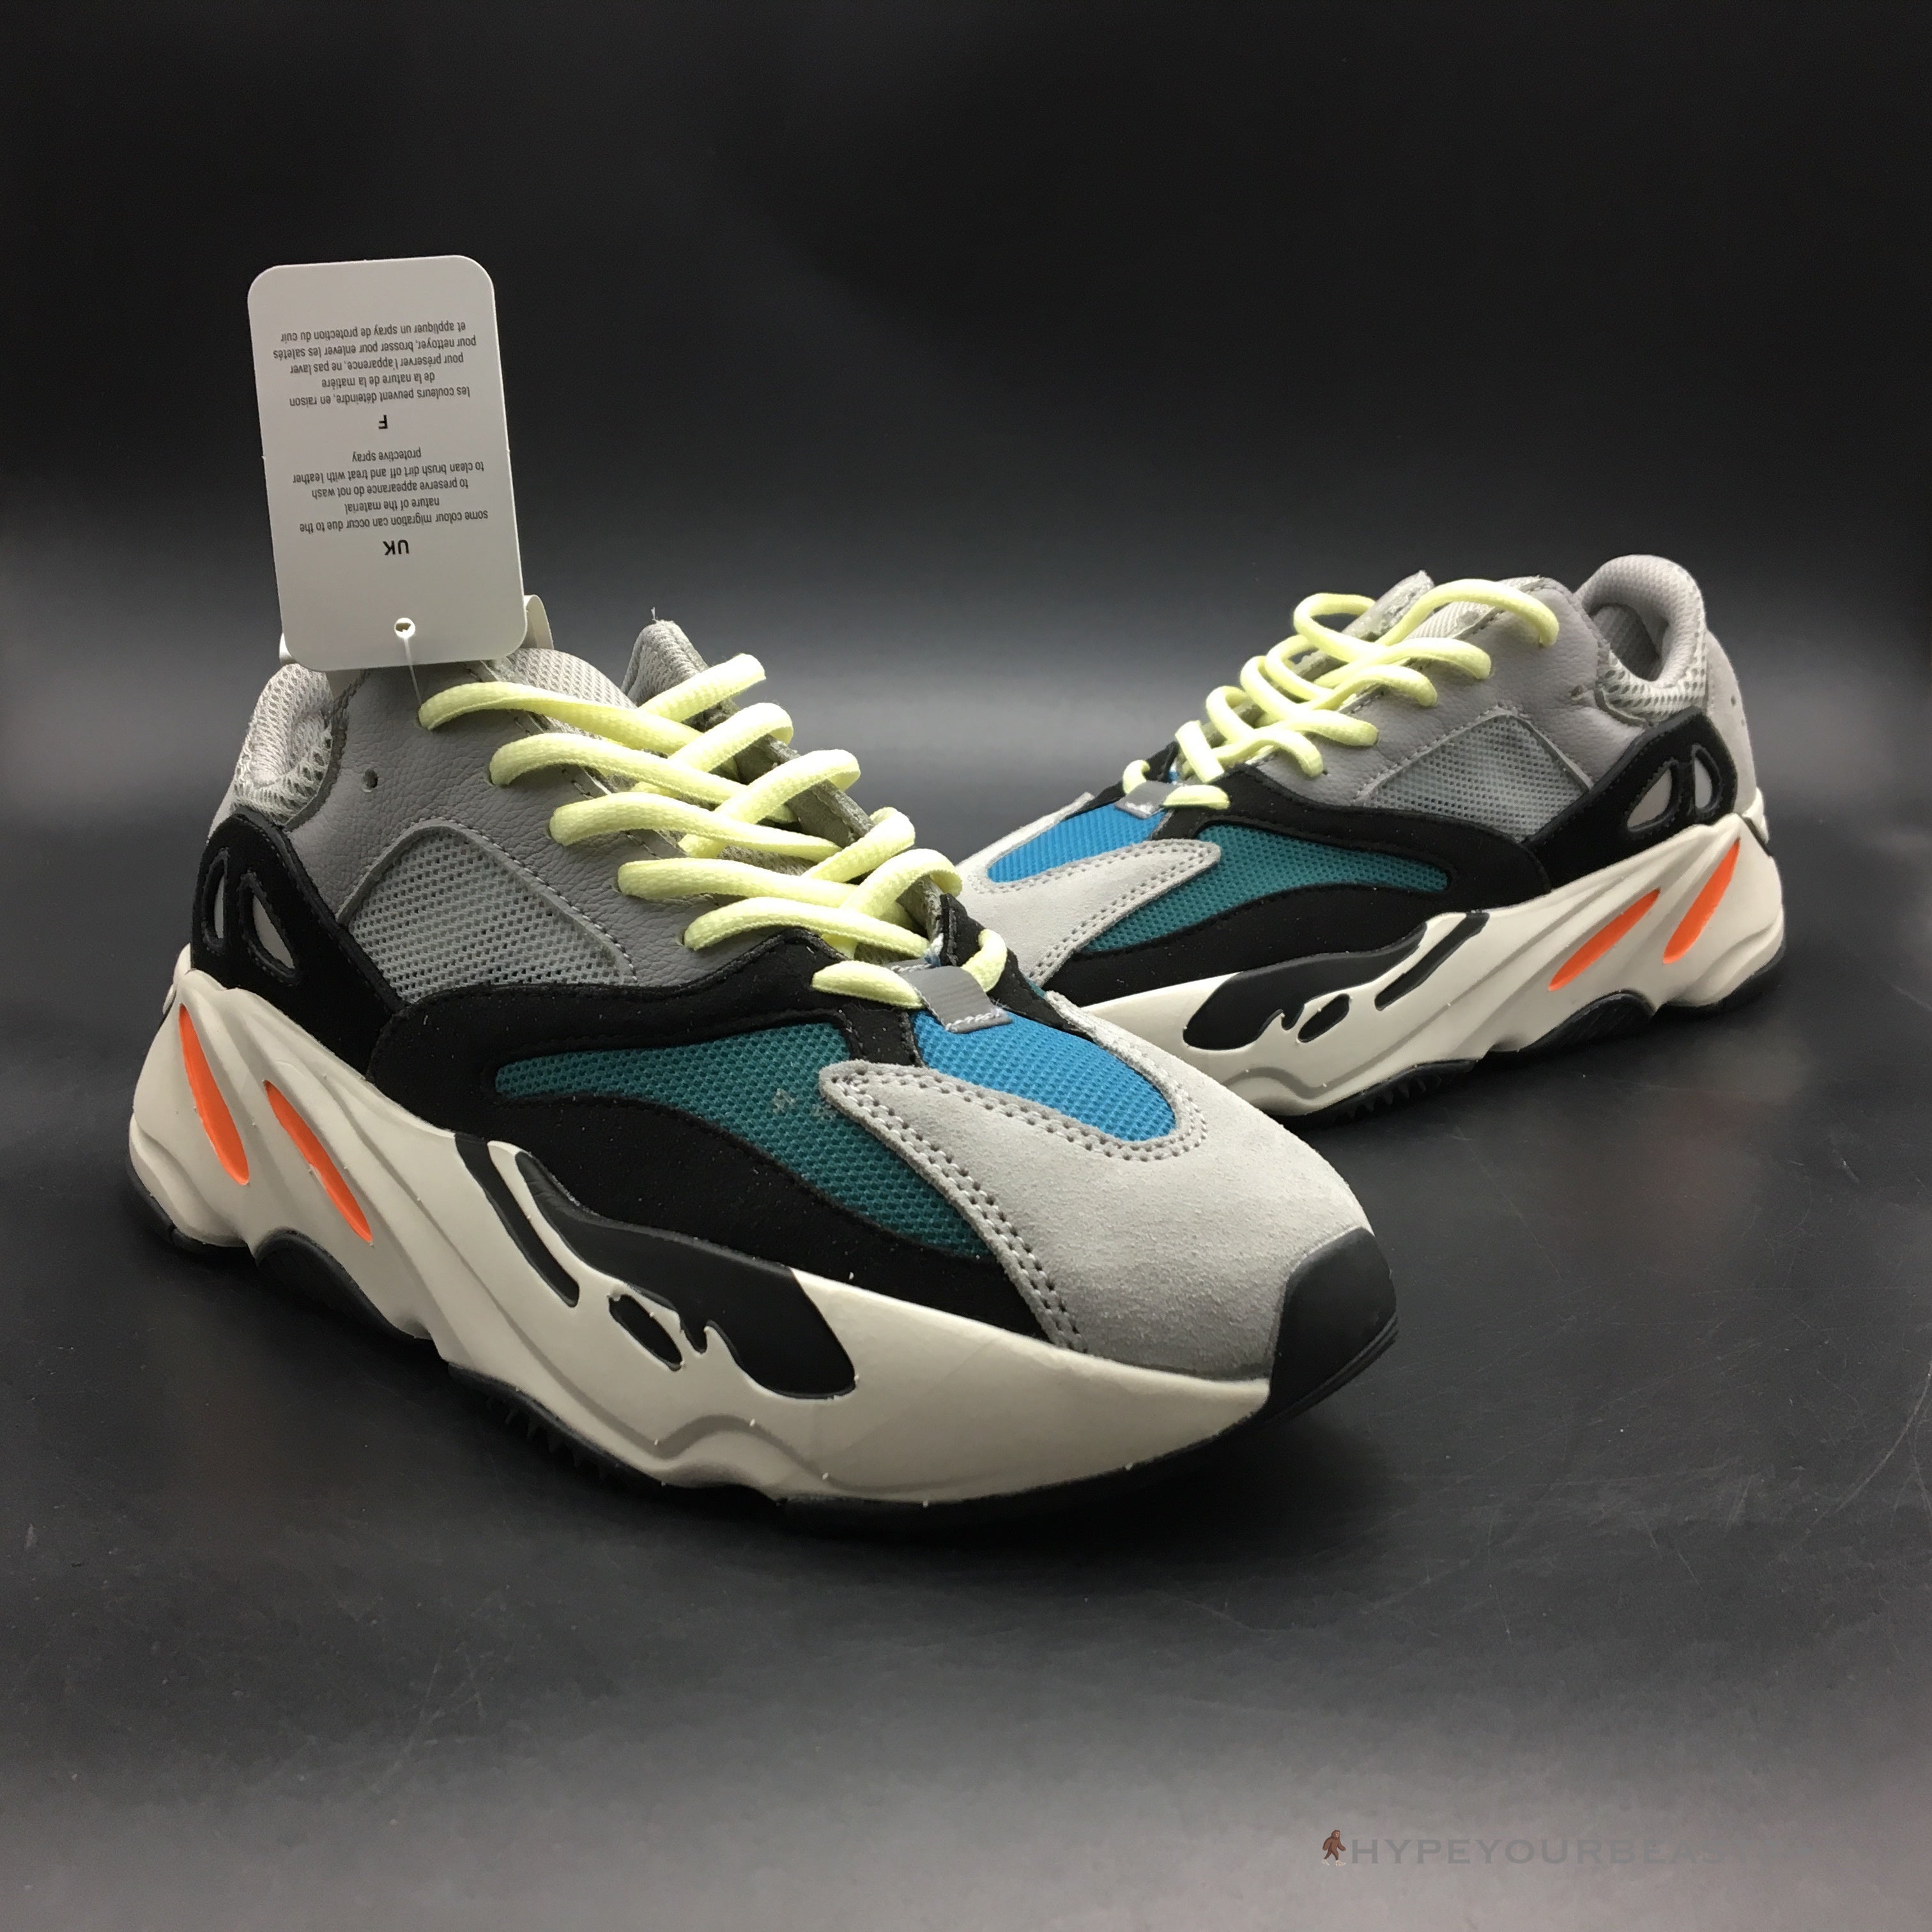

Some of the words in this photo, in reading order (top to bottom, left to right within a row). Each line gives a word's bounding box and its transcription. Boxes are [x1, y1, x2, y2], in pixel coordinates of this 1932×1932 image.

[373, 323, 398, 335] spray
[400, 325, 411, 334] un
[413, 320, 455, 334] appliquer
[457, 321, 466, 332] et
[280, 332, 298, 344] cuir
[300, 332, 312, 342] du
[314, 326, 358, 341] protection
[360, 328, 372, 339] de
[381, 341, 414, 352] brosser
[415, 337, 455, 350] nettoyer,
[456, 334, 477, 347] pour
[307, 346, 321, 358] les
[324, 344, 356, 356] enlever
[359, 341, 378, 353] pour
[273, 348, 305, 361] saletés
[400, 353, 442, 367] préserver
[443, 351, 464, 364] pour
[313, 360, 330, 372] pas
[331, 362, 342, 371] ne
[344, 356, 398, 371] l'apparence,
[290, 364, 312, 376] laver
[358, 377, 367, 388] la
[369, 376, 380, 387] de
[382, 374, 411, 385] nature
[413, 373, 422, 384] la
[424, 372, 435, 383] de
[321, 378, 356, 390] matière
[379, 388, 414, 402] peuvent
[417, 387, 455, 400] couleurs
[456, 386, 470, 398] les
[289, 397, 318, 408] raison
[320, 395, 331, 404] en
[334, 392, 377, 406] déteindre,
[378, 414, 388, 430] F
[352, 450, 376, 462] spray
[378, 447, 422, 462] protective
[404, 466, 420, 477] dirt
[422, 464, 447, 477] brush
[449, 462, 473, 473] clean
[475, 461, 484, 471] to
[293, 472, 324, 485] leather
[326, 471, 346, 483] with
[348, 470, 368, 481] treat
[370, 468, 387, 480] and
[390, 467, 402, 479] off
[367, 480, 417, 494] appearance
[419, 477, 458, 490] preserve
[459, 479, 469, 489] to
[311, 488, 335, 500] wash
[337, 487, 352, 498] not
[353, 486, 365, 497] do
[344, 502, 381, 515] material
[383, 500, 398, 512] the
[400, 499, 410, 511] of
[411, 497, 440, 508] nature
[390, 512, 432, 526] migration
[435, 512, 463, 525] colour
[464, 510, 488, 521] some
[300, 523, 314, 534] the
[316, 521, 325, 532] to
[326, 521, 344, 532] due
[346, 519, 370, 528] occur
[372, 518, 388, 527] can
[382, 539, 410, 556] UK
